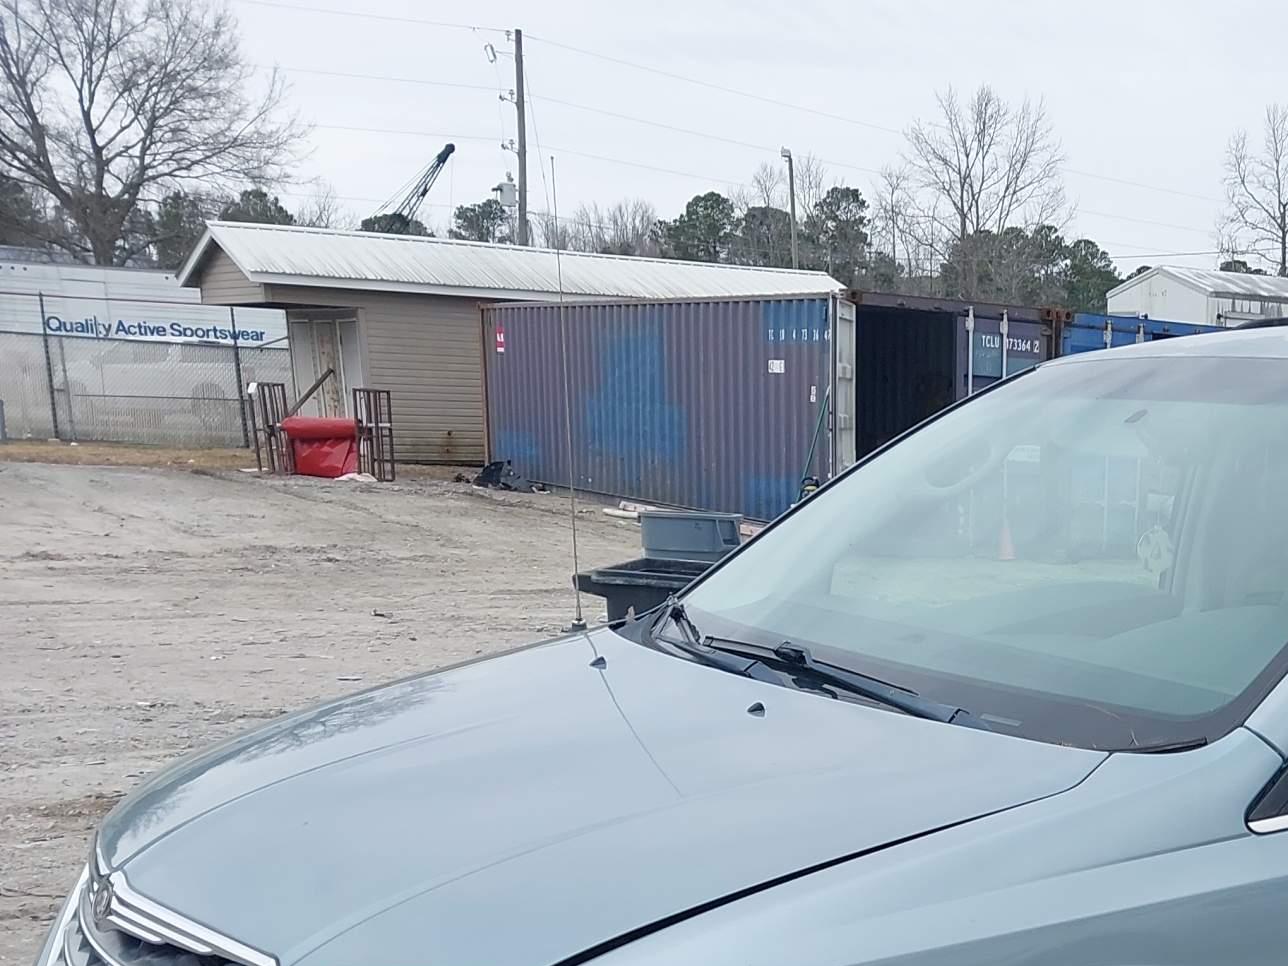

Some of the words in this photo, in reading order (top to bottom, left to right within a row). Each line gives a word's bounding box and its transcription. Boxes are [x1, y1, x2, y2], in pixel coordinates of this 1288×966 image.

[115, 320, 166, 337] Active
[169, 322, 265, 341] Sportswear
[981, 335, 1000, 348] TCLU
